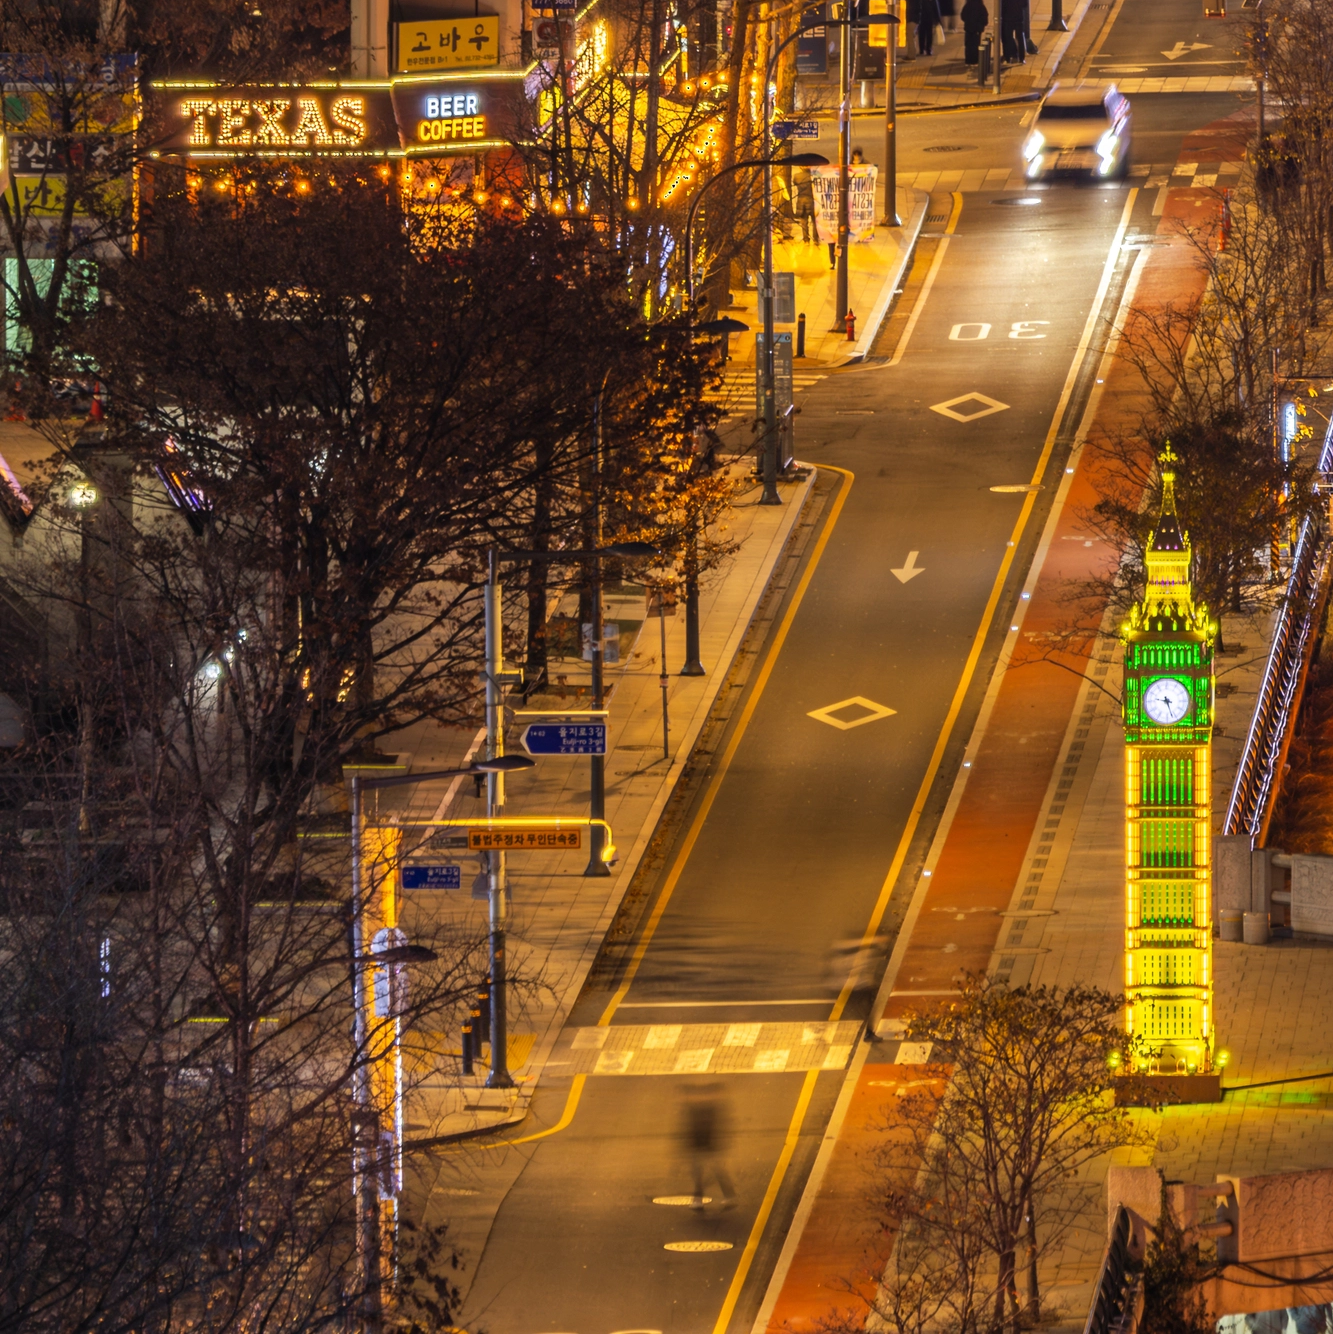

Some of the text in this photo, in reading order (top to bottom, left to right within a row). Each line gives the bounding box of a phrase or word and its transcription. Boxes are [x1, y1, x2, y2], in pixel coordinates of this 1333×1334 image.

[410, 23, 491, 54] 고바우
[426, 94, 478, 119] BEER
[180, 97, 366, 148] TEXAS
[418, 117, 484, 142] COFFEE
[558, 726, 604, 738] 을지로3길
[562, 737, 604, 747] Eulji-ro 3-gil
[472, 833, 525, 846] 불법주정차
[526, 832, 578, 846] 무인단속중
